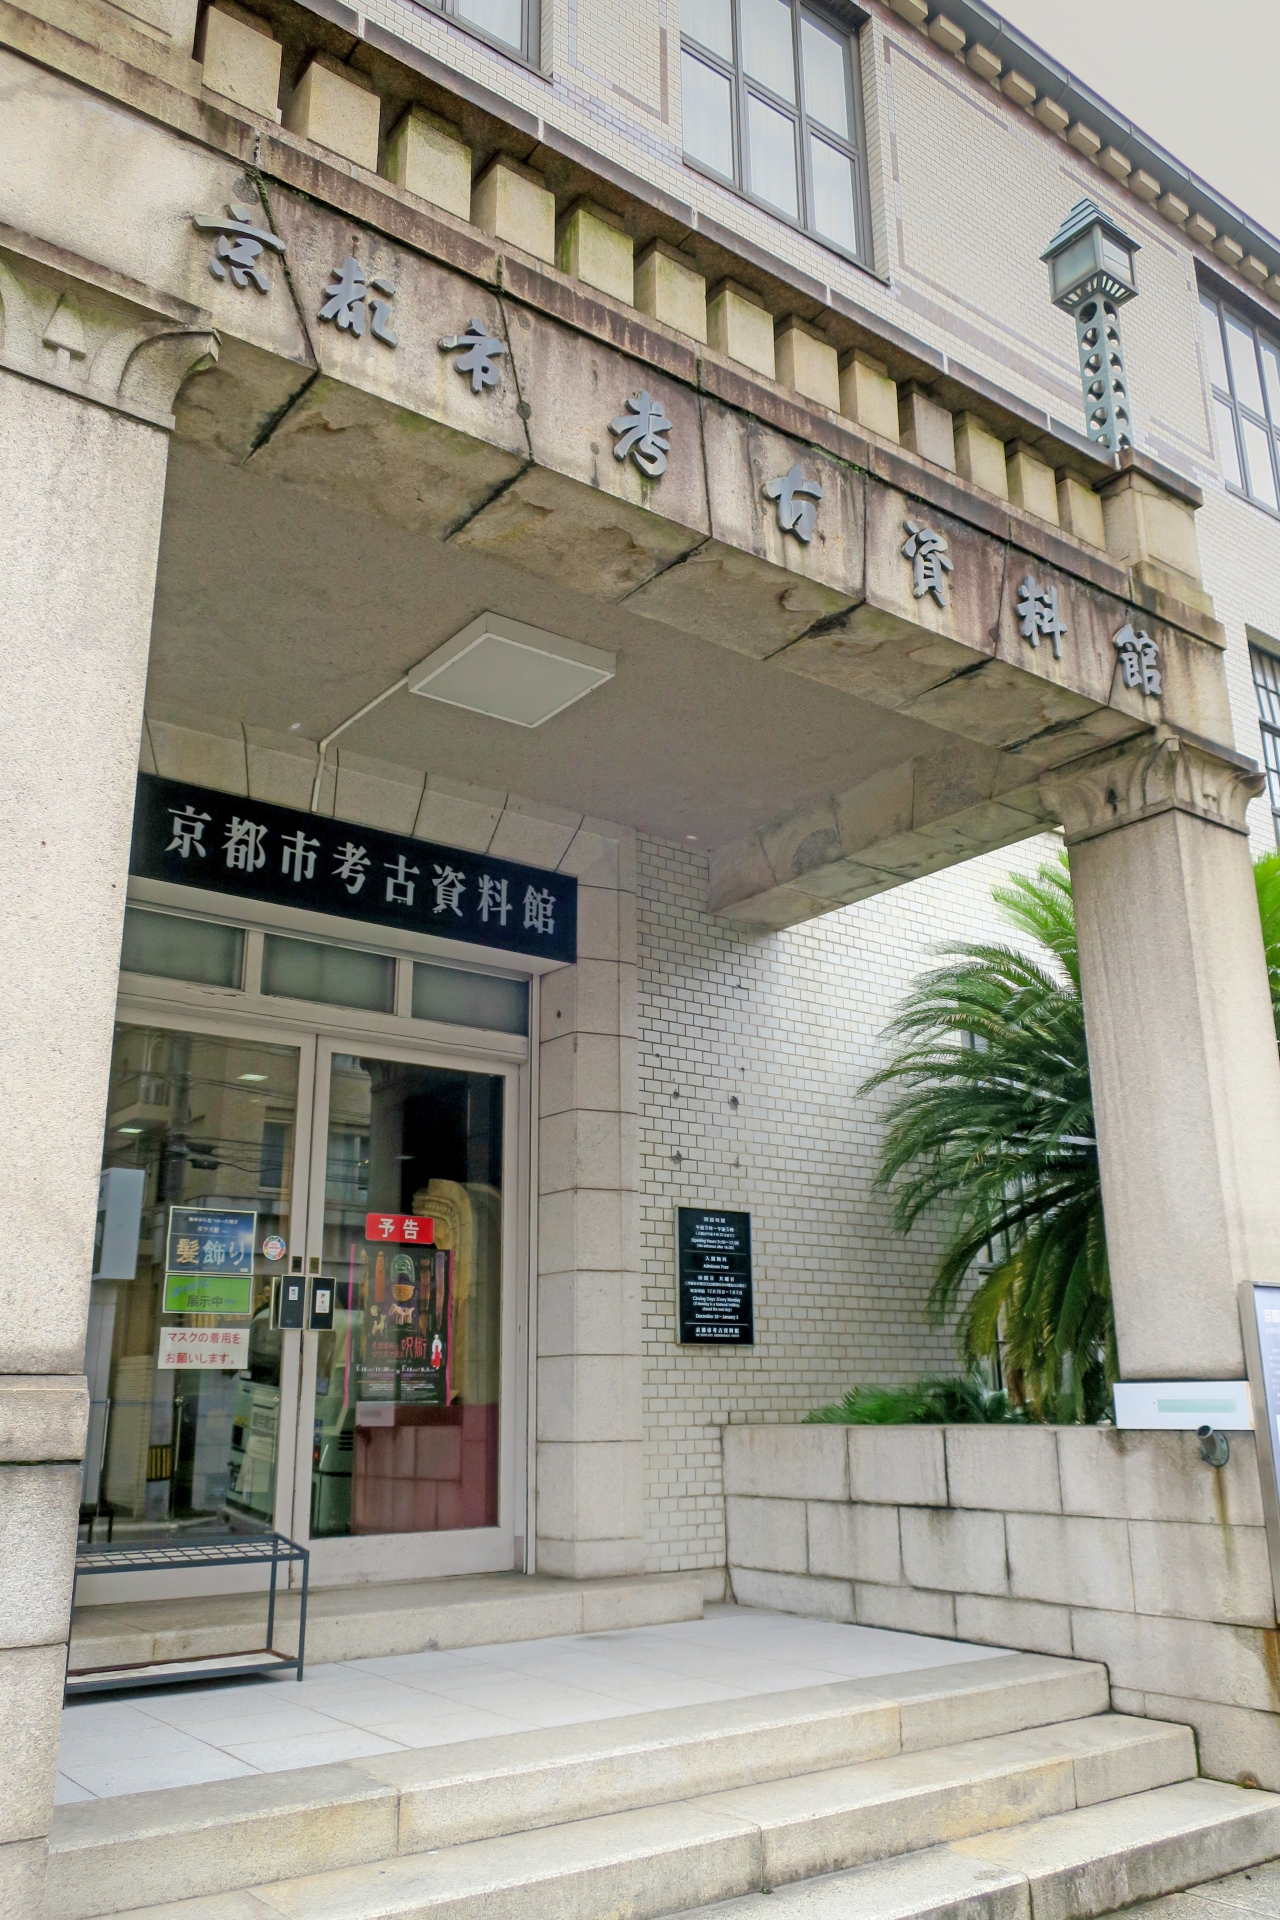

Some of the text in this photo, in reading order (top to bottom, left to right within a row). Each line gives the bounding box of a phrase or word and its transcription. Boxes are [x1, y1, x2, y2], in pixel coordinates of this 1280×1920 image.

[192, 203, 1163, 697] 京都市考古資料館
[164, 805, 557, 934] 京都市考古資料館
[378, 1218, 420, 1240] 予告
[175, 1238, 246, 1266] 髪飾り
[166, 1331, 242, 1345] マスクの着用を
[401, 1336, 427, 1360] 呪術
[164, 1351, 235, 1365] お願いします。
